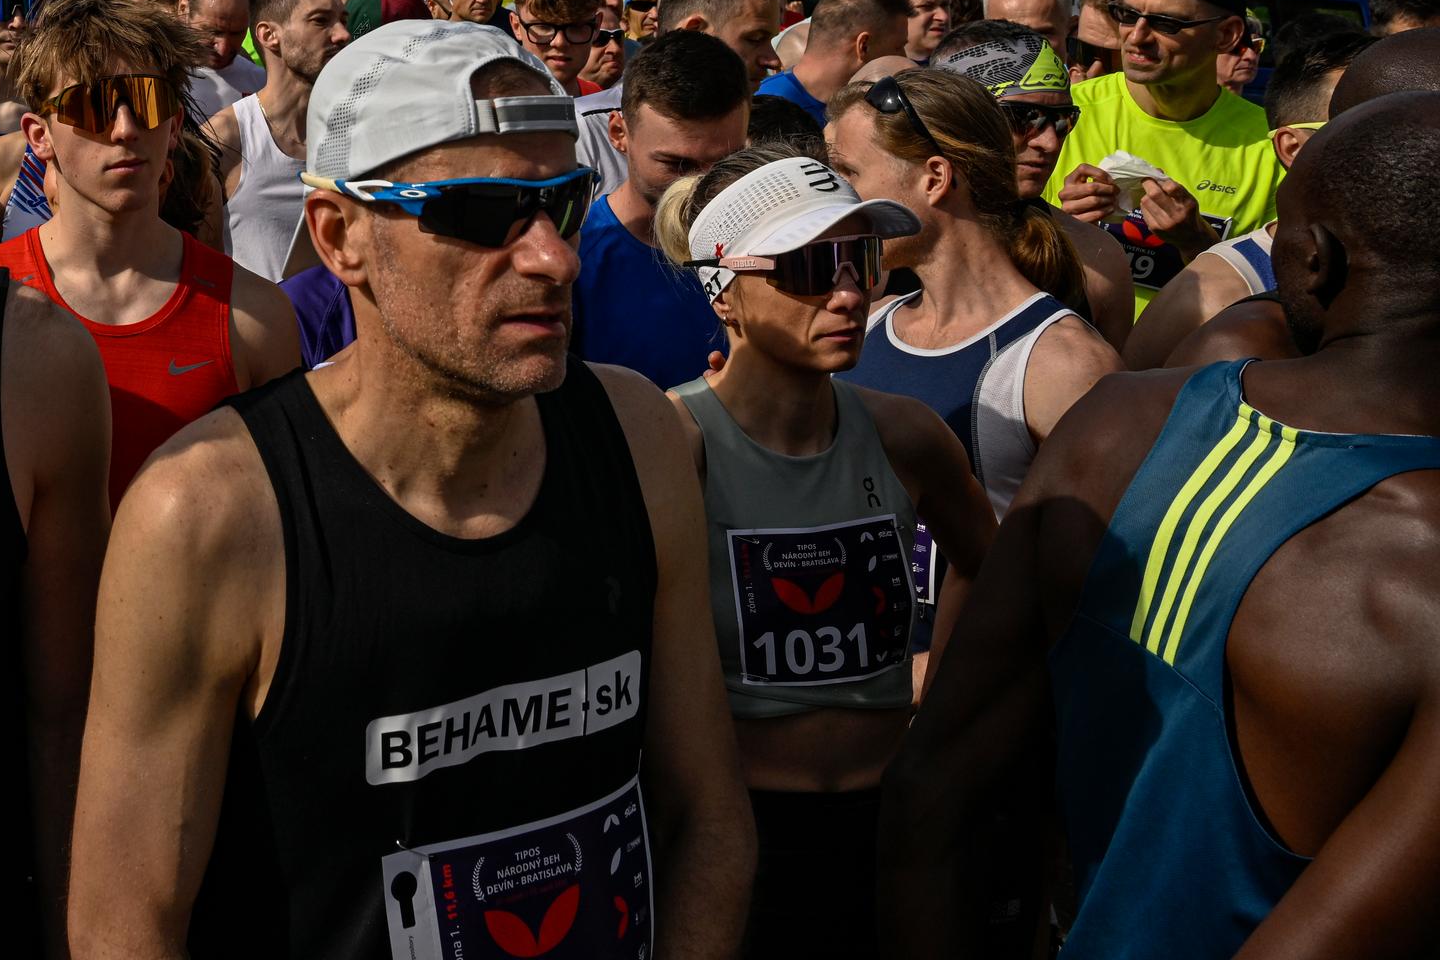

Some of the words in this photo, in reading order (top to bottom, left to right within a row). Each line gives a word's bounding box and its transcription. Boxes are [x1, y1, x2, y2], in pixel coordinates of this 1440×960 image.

[801, 557, 840, 568] BRATISLAVA
[816, 549, 831, 557] BEH
[753, 622, 870, 676] 1031
[514, 846, 541, 862] TIPOS
[441, 863, 456, 887] km
[486, 877, 515, 896] DEVÍN
[520, 860, 573, 887] BRATISLAVA
[496, 856, 543, 880] NÁRODNÝ
[543, 853, 561, 867] BEH
